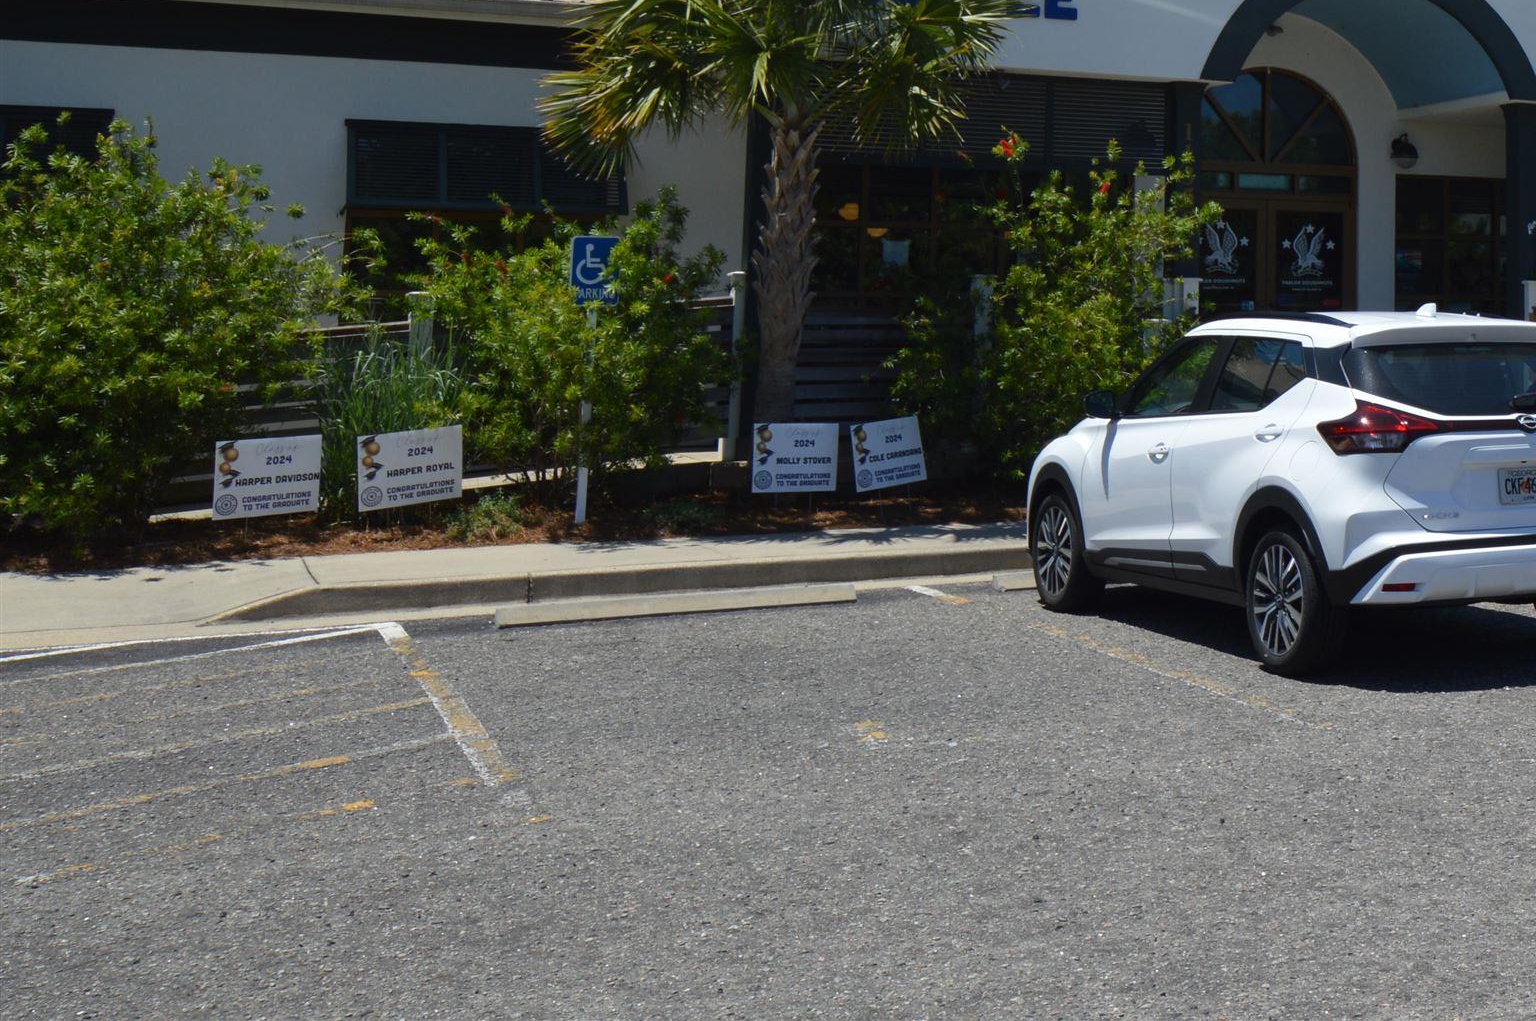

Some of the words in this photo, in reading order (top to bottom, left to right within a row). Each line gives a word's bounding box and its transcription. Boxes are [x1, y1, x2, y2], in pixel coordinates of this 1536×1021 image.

[793, 439, 815, 447] 2024
[885, 434, 903, 443] 2024
[407, 446, 433, 456] 2024
[868, 453, 885, 463] COLE
[265, 454, 292, 466] 2024
[776, 457, 800, 465] MOLLY
[802, 456, 832, 465] STOVER
[386, 466, 423, 478] HARPER
[425, 462, 455, 473] ROYAL
[874, 463, 921, 477] CONGRATULATIONS
[235, 476, 272, 487] HARPER
[275, 472, 320, 484] DAVIDSON
[386, 479, 455, 494] CONGRATULATIONS
[242, 490, 311, 504] CONGRATULATIONS
[388, 494, 398, 502] TO
[400, 491, 414, 499] THE
[416, 486, 454, 498] GRADUATE
[243, 503, 253, 512] TO
[255, 502, 270, 511] THE
[272, 498, 310, 509] GRADUATE
